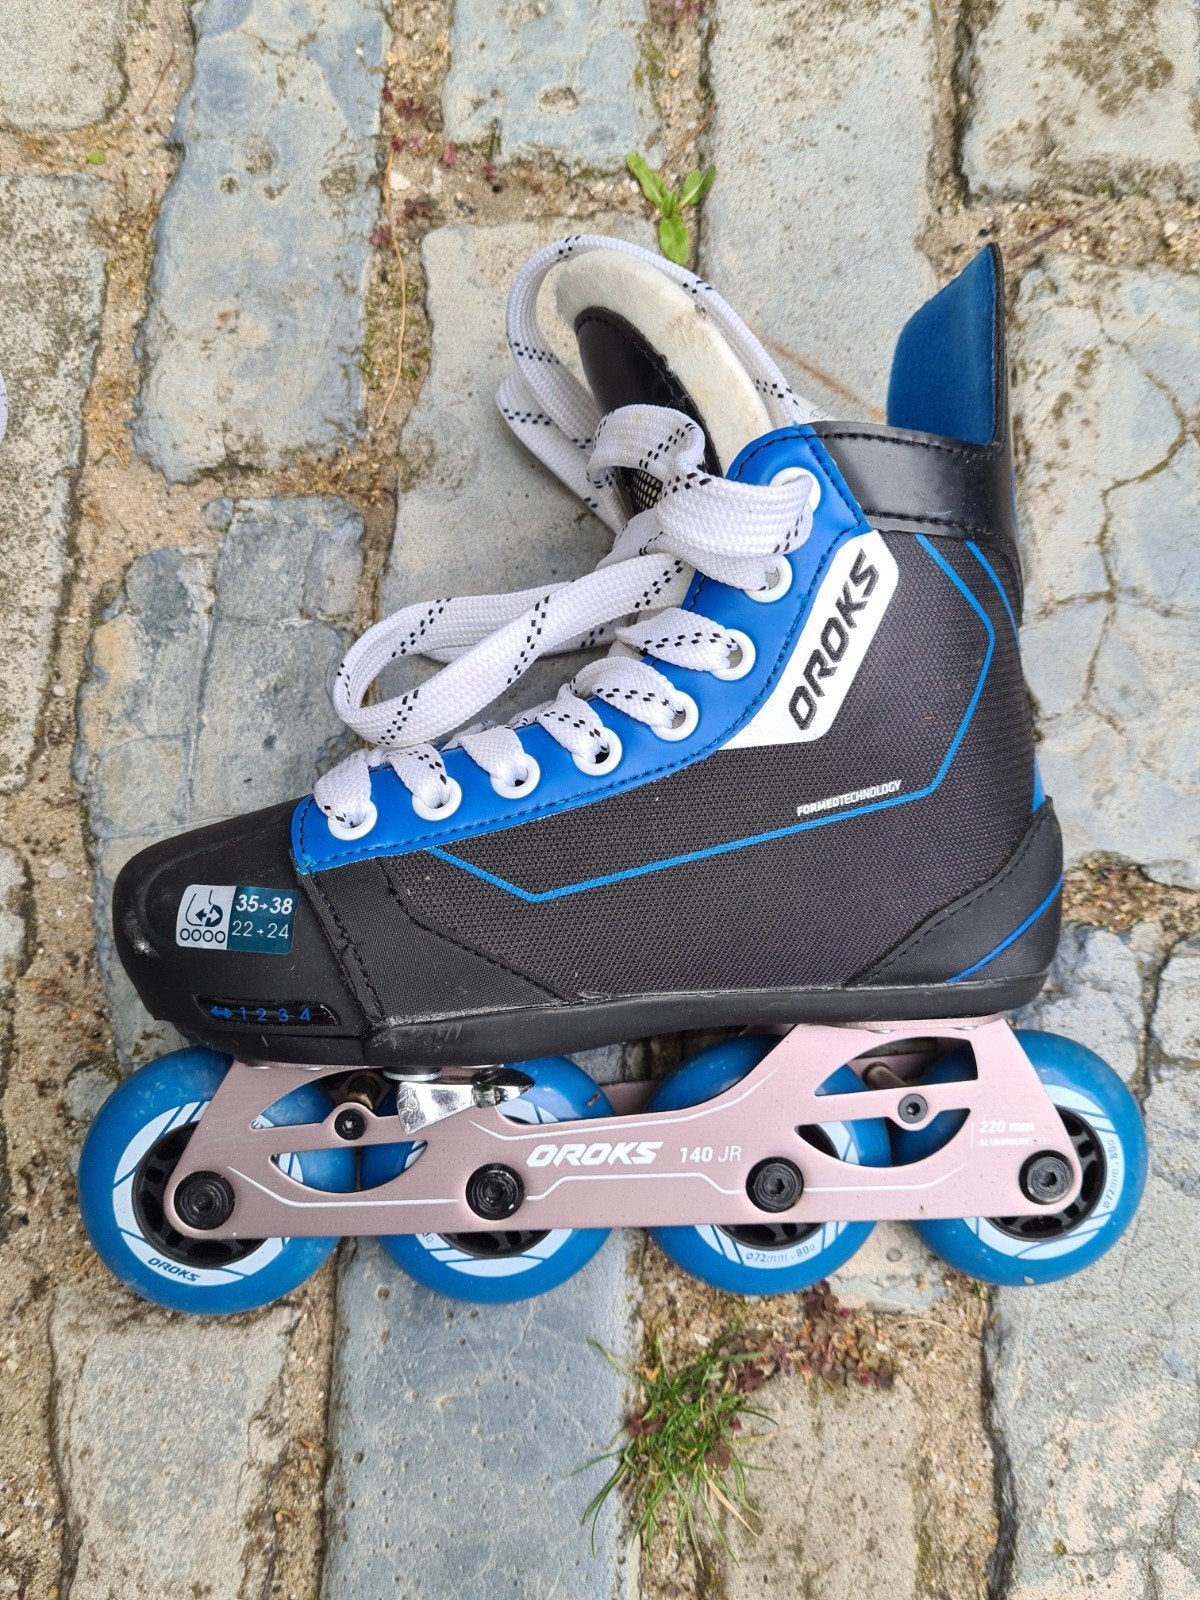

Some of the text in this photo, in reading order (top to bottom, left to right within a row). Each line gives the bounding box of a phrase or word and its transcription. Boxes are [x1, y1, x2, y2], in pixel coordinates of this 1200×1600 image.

[789, 548, 879, 730] OROKS
[235, 894, 293, 915] 35 38
[231, 920, 289, 940] 22 24
[240, 1007, 311, 1022] 1 2 3 4
[979, 1120, 1006, 1133] 220
[526, 1141, 742, 1168] OROKS 140 JR
[148, 1257, 201, 1282] OROKS
